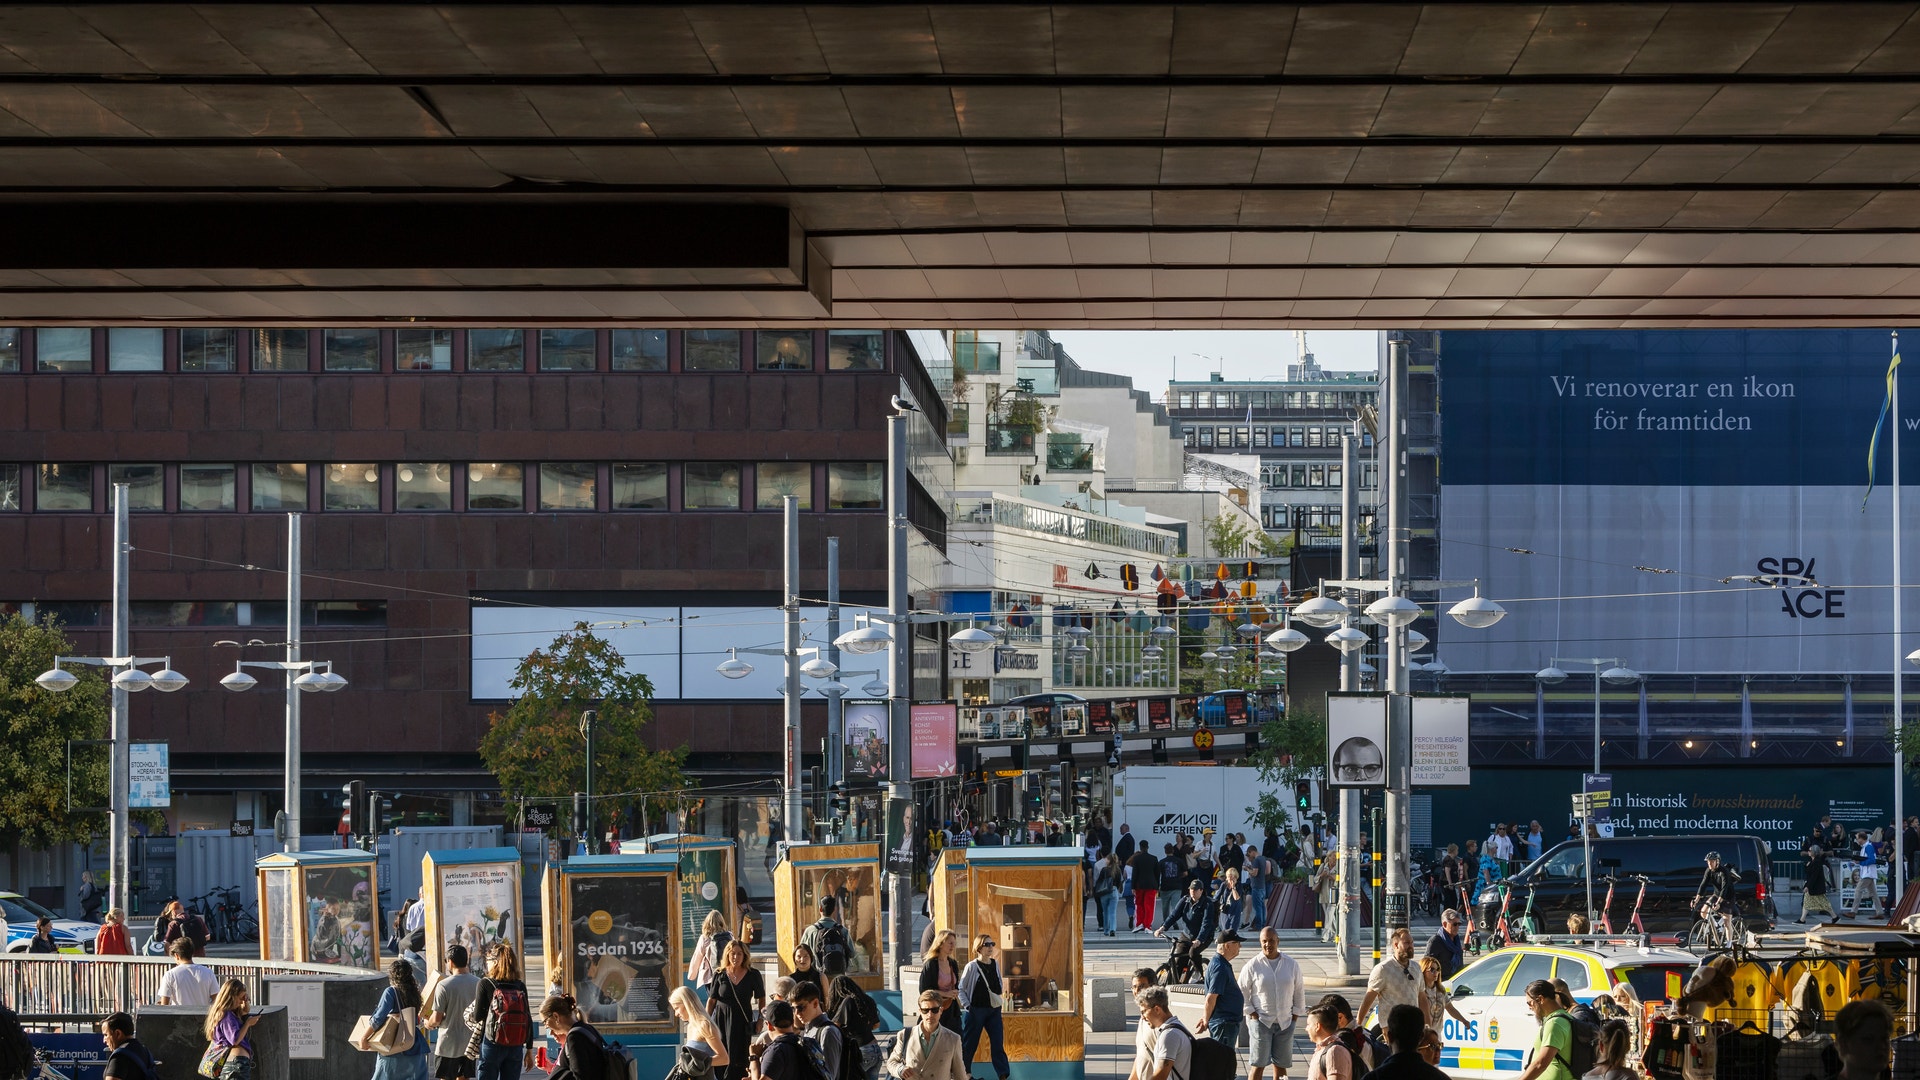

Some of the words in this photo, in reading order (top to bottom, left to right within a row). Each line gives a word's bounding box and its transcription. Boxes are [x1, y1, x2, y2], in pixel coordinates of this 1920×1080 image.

[1550, 375, 1576, 397] Vi
[1584, 379, 1698, 398] renoverar
[1707, 383, 1733, 398] en
[1742, 375, 1796, 398] ikon
[1593, 408, 1628, 430] för
[1637, 408, 1752, 430] framtiden
[1626, 792, 1688, 808] historisk
[1692, 794, 1804, 809] bronsskimrande
[1638, 814, 1670, 829] med
[1674, 814, 1738, 830] moderna
[1744, 815, 1793, 830] kontor
[578, 942, 626, 956] Sedan
[630, 941, 664, 955] 1936
